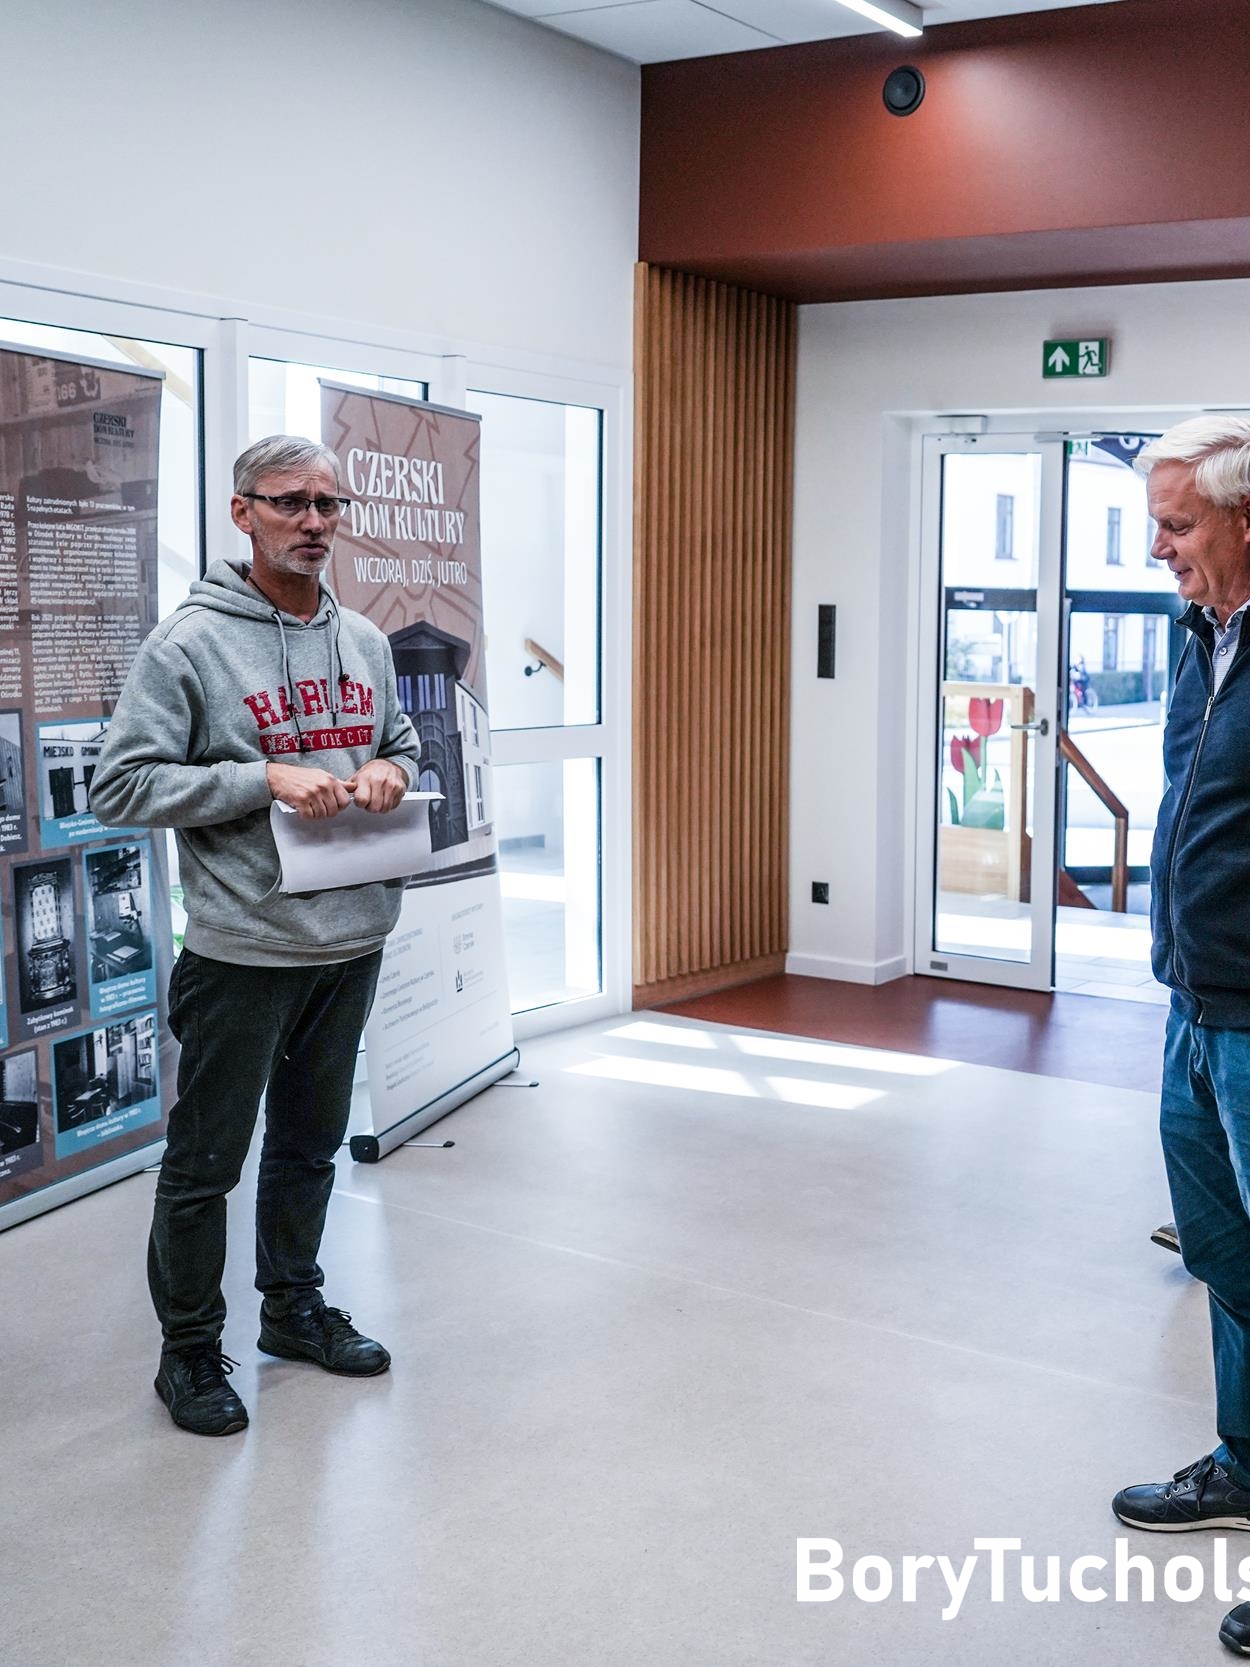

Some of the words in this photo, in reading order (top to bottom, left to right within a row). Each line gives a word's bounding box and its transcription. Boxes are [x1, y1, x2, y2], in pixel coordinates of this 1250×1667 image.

[347, 447, 444, 505] CZERSKI
[350, 500, 392, 539] DOM
[394, 505, 465, 545] KULTURY
[353, 556, 410, 588] WCZORAJ,
[411, 553, 436, 587] DZIŚ,
[437, 560, 468, 589] JUTRO
[243, 678, 375, 731] HARLEM
